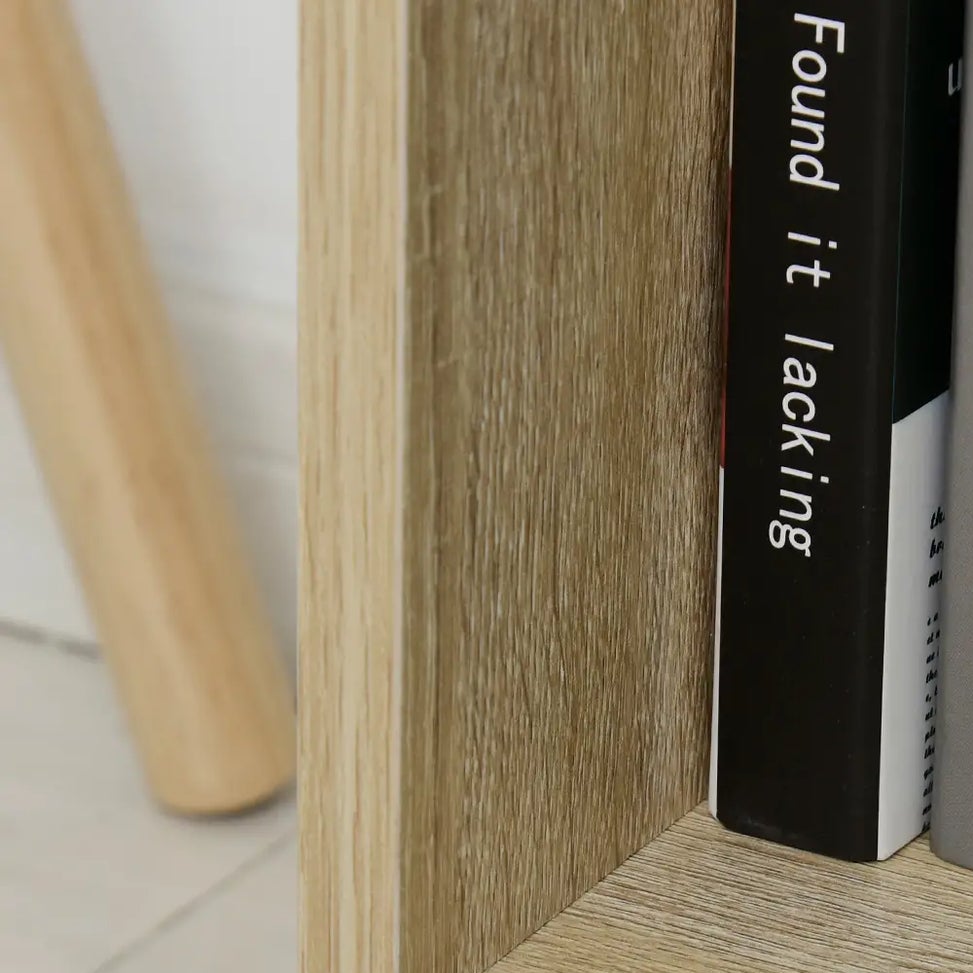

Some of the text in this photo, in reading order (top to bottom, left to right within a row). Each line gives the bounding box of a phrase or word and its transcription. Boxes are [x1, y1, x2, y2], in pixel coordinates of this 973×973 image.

[768, 12, 845, 558] Found it lacking
